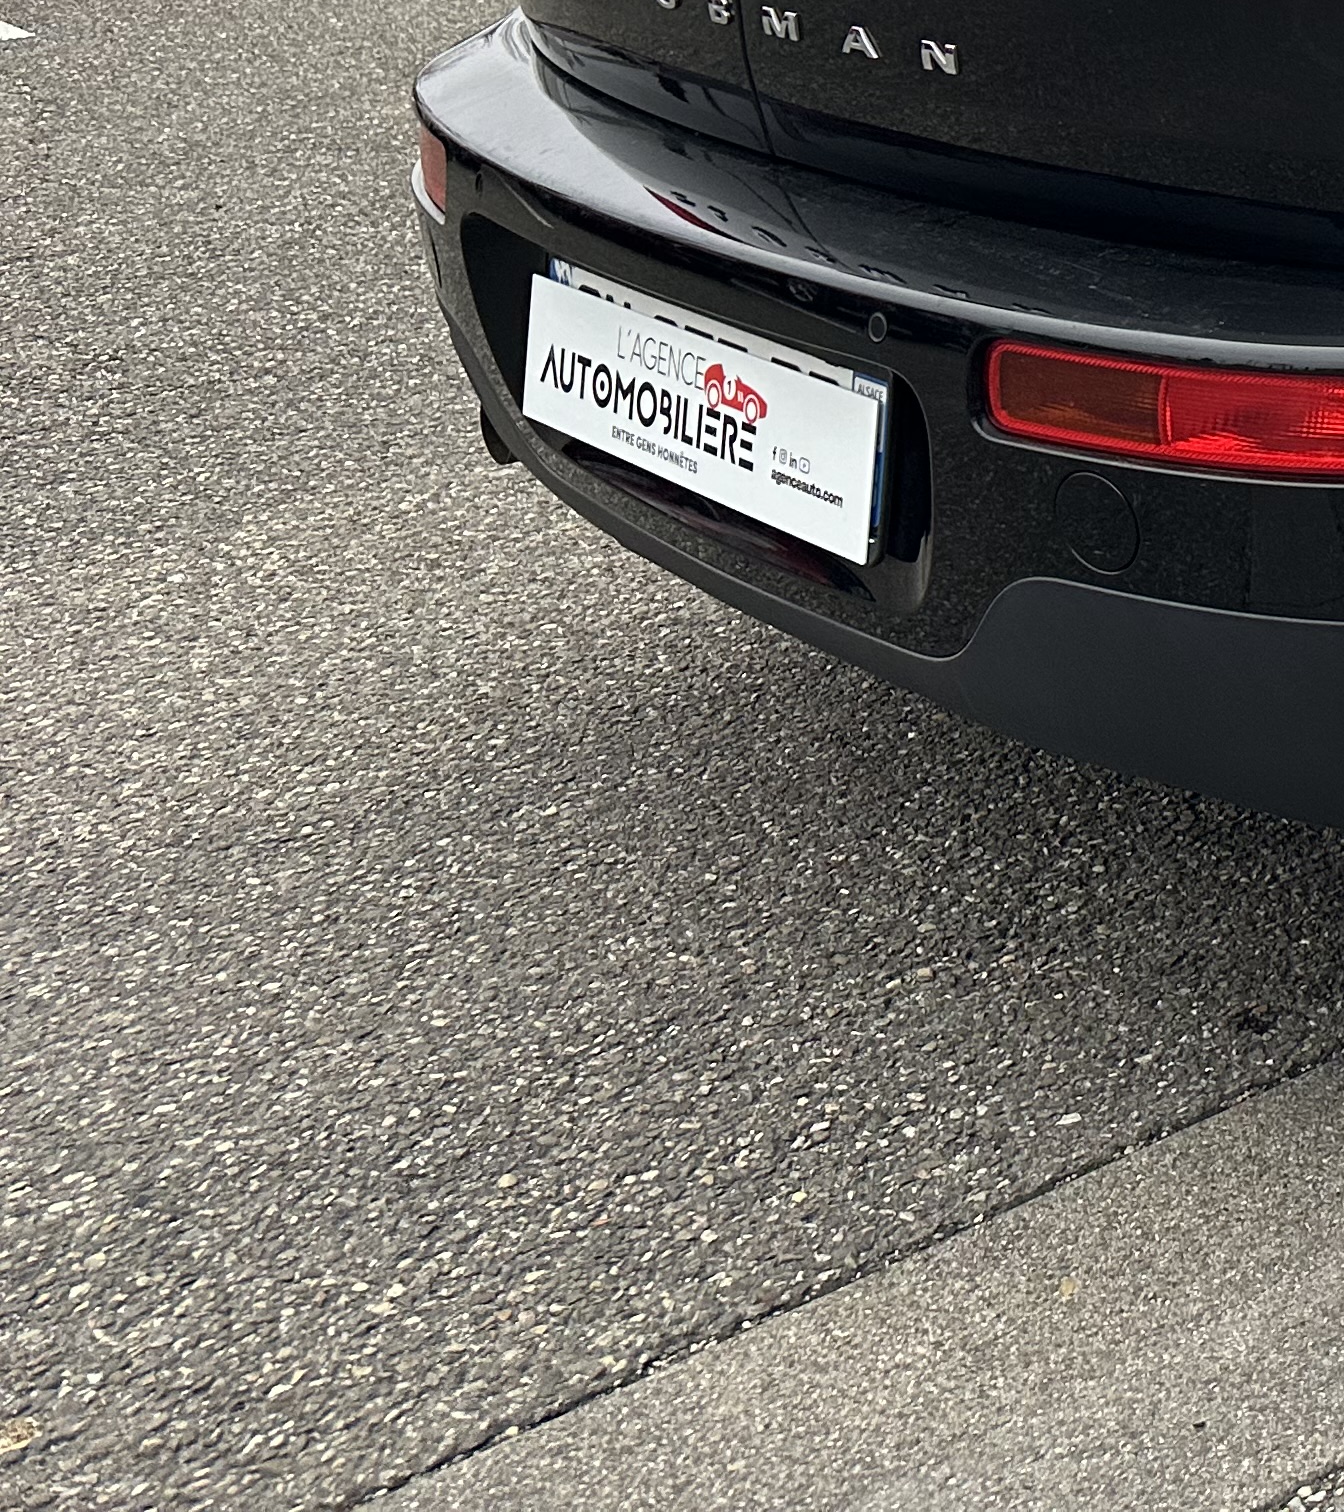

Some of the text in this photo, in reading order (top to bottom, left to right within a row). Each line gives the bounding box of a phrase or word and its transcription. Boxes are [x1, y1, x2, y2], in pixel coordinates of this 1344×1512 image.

[617, 325, 707, 391] L'AGENCE
[611, 425, 698, 474] ENTRE GENS HONNÊTES
[771, 468, 844, 508] agenceauto.com
